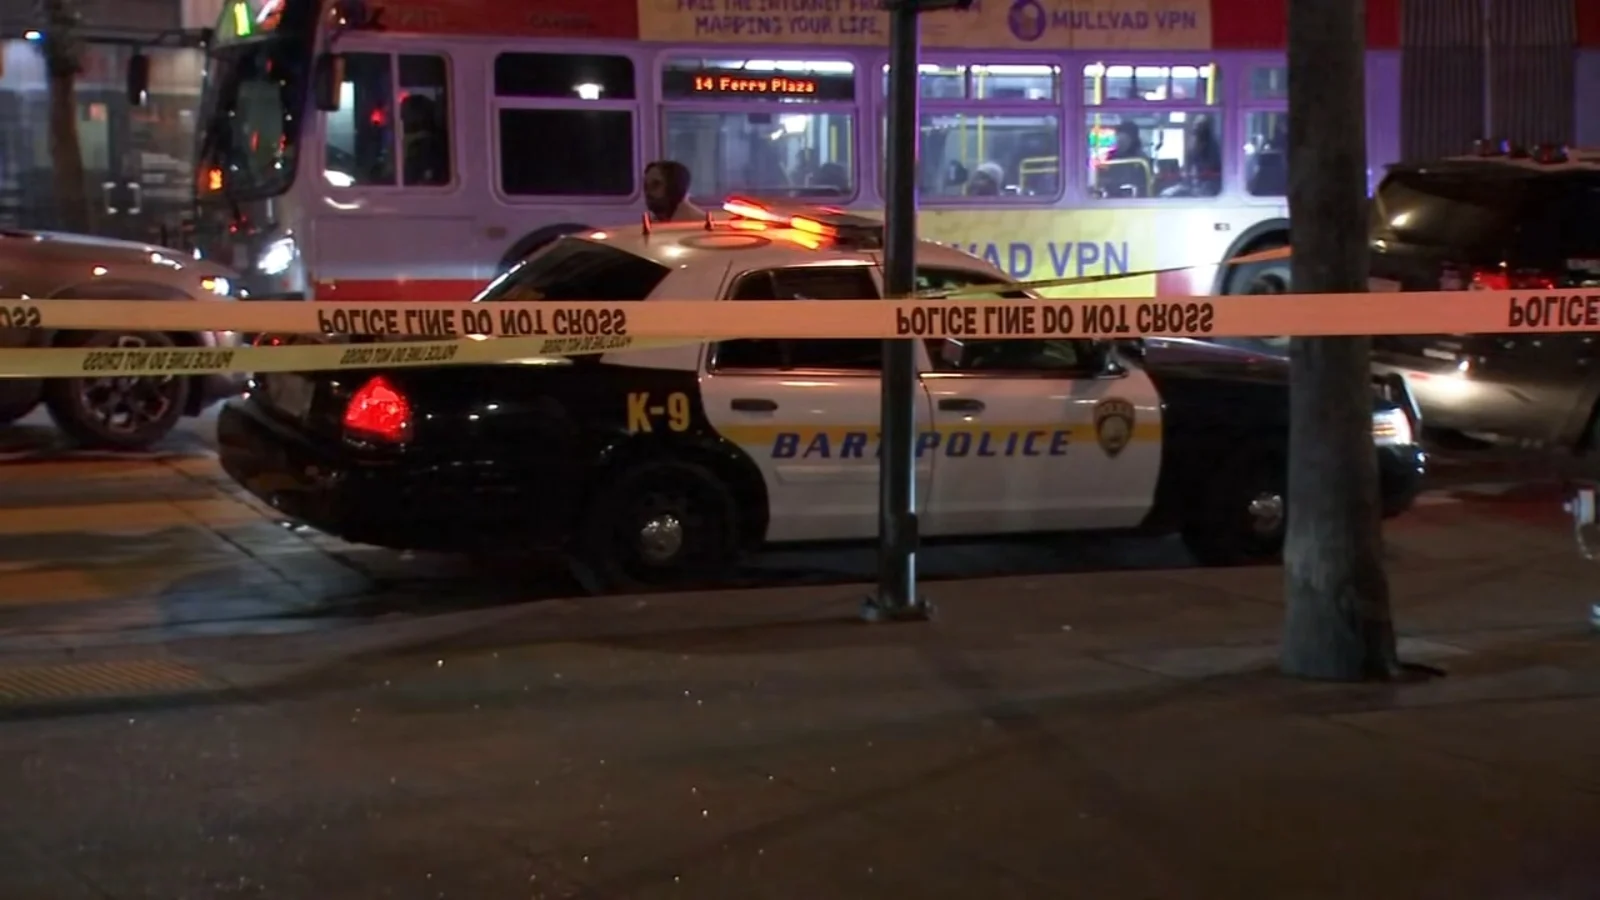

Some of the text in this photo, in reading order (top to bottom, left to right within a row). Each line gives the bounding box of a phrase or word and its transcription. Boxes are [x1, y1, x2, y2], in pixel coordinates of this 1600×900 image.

[694, 16, 783, 36] MAPPING
[789, 17, 834, 35] YOUR
[1051, 11, 1197, 30] MULLVAD VPN
[695, 77, 815, 93] 14 Ferry Plaza
[1048, 241, 1129, 277] VPN
[627, 392, 690, 432] K-9
[915, 430, 1073, 458] POLICE
